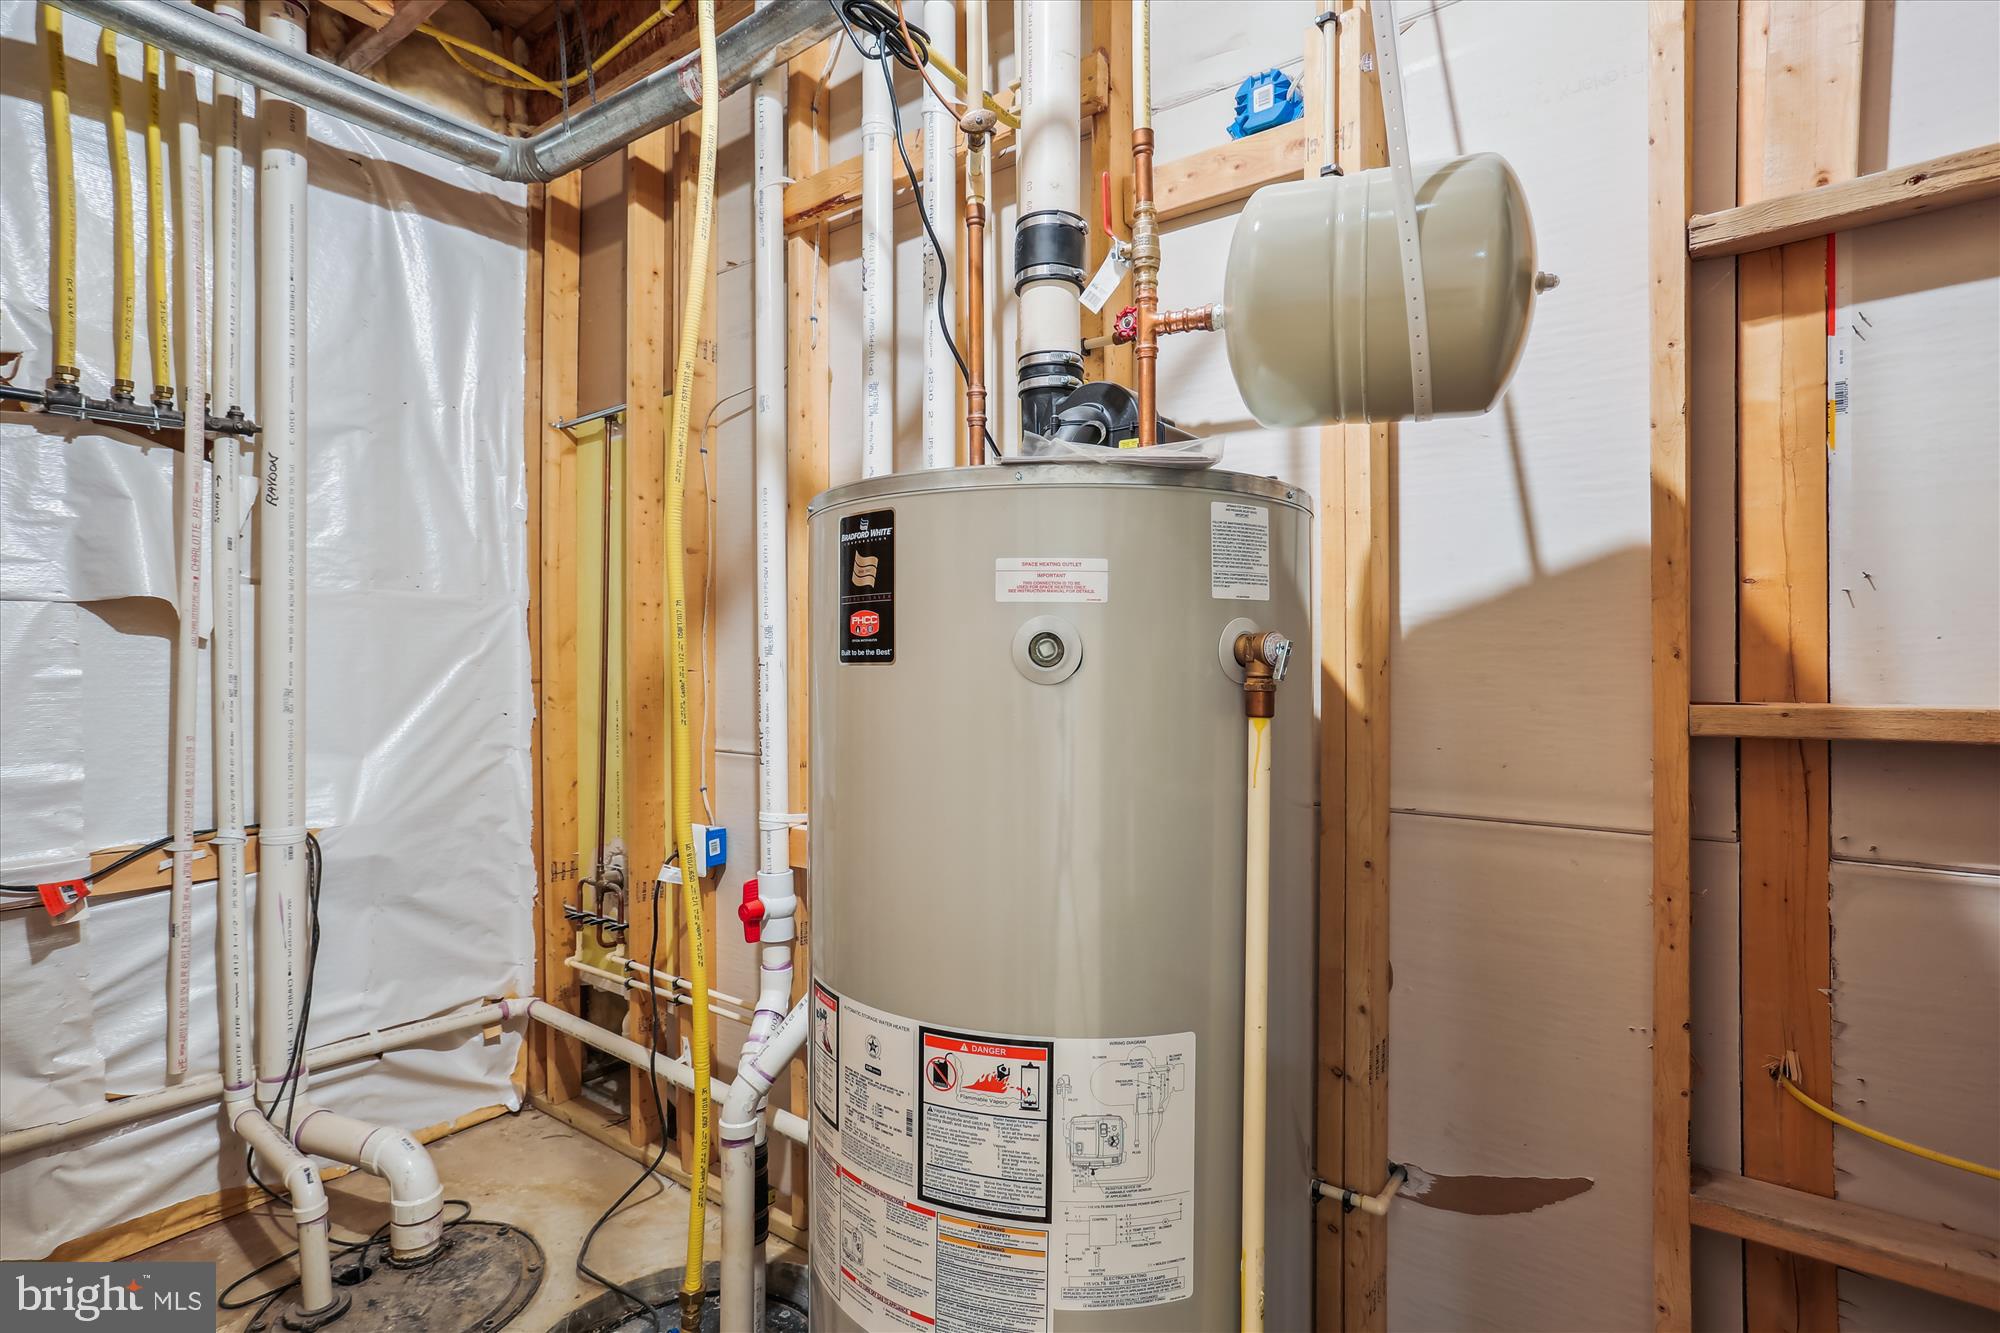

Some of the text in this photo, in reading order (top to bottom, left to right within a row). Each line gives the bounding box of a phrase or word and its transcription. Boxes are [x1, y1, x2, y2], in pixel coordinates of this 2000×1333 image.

[266, 452, 279, 507] RAYDON
[192, 497, 202, 519] PIPE
[841, 527, 892, 543] BRADFORD WHITE
[191, 523, 201, 572] CHARLOTTE
[851, 615, 878, 625] PHCC
[841, 649, 851, 657] Built
[866, 648, 875, 656] the
[879, 1019, 892, 1027] WATER
[893, 1024, 910, 1032] HEATER
[971, 1046, 1007, 1056] DANGER
[960, 1093, 1008, 1106] Flammable Vapors
[982, 1224, 1006, 1232] WARNING
